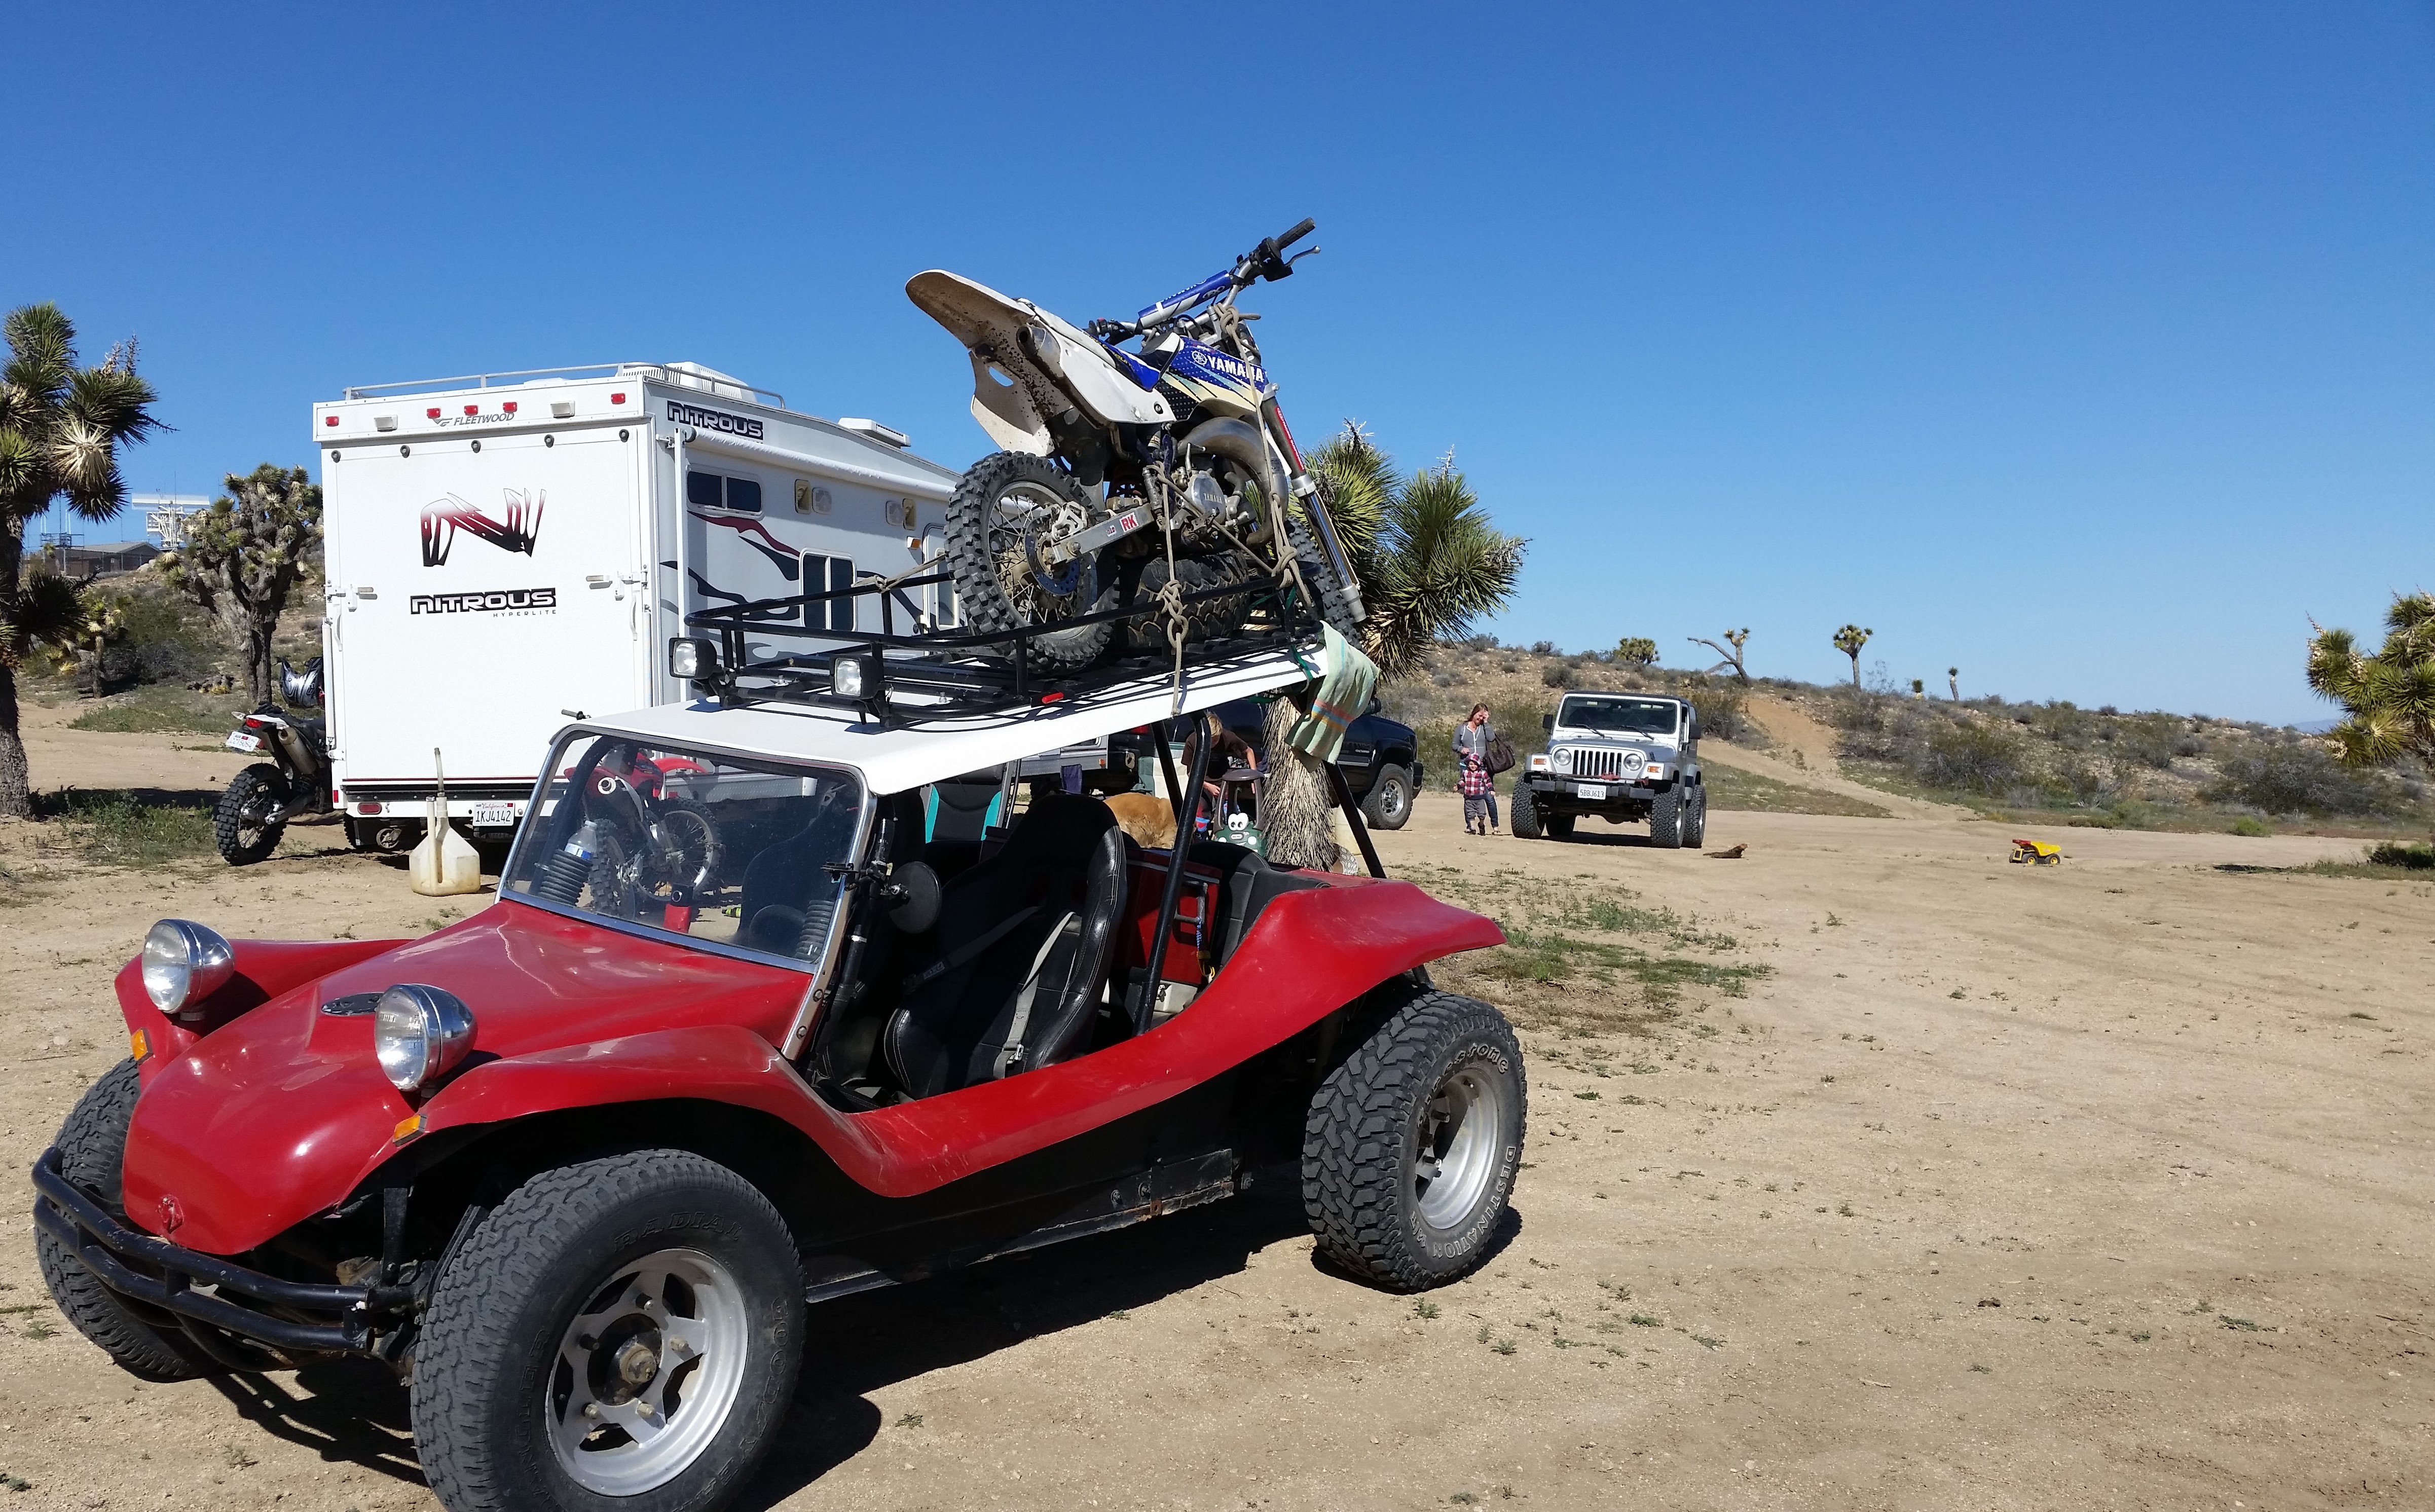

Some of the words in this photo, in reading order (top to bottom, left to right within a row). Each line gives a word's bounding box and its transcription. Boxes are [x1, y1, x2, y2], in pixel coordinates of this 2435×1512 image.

[454, 413, 514, 426] FLEETWOOD
[668, 402, 762, 439] NITROUS
[1203, 492, 1223, 504] YAMAHA
[1121, 514, 1138, 531] RK
[411, 588, 556, 614] NITROUS
[1580, 789, 1604, 797] 5BBJ613
[475, 810, 511, 823] 1KJ4142
[1432, 1146, 1517, 1259] DESTINATION
